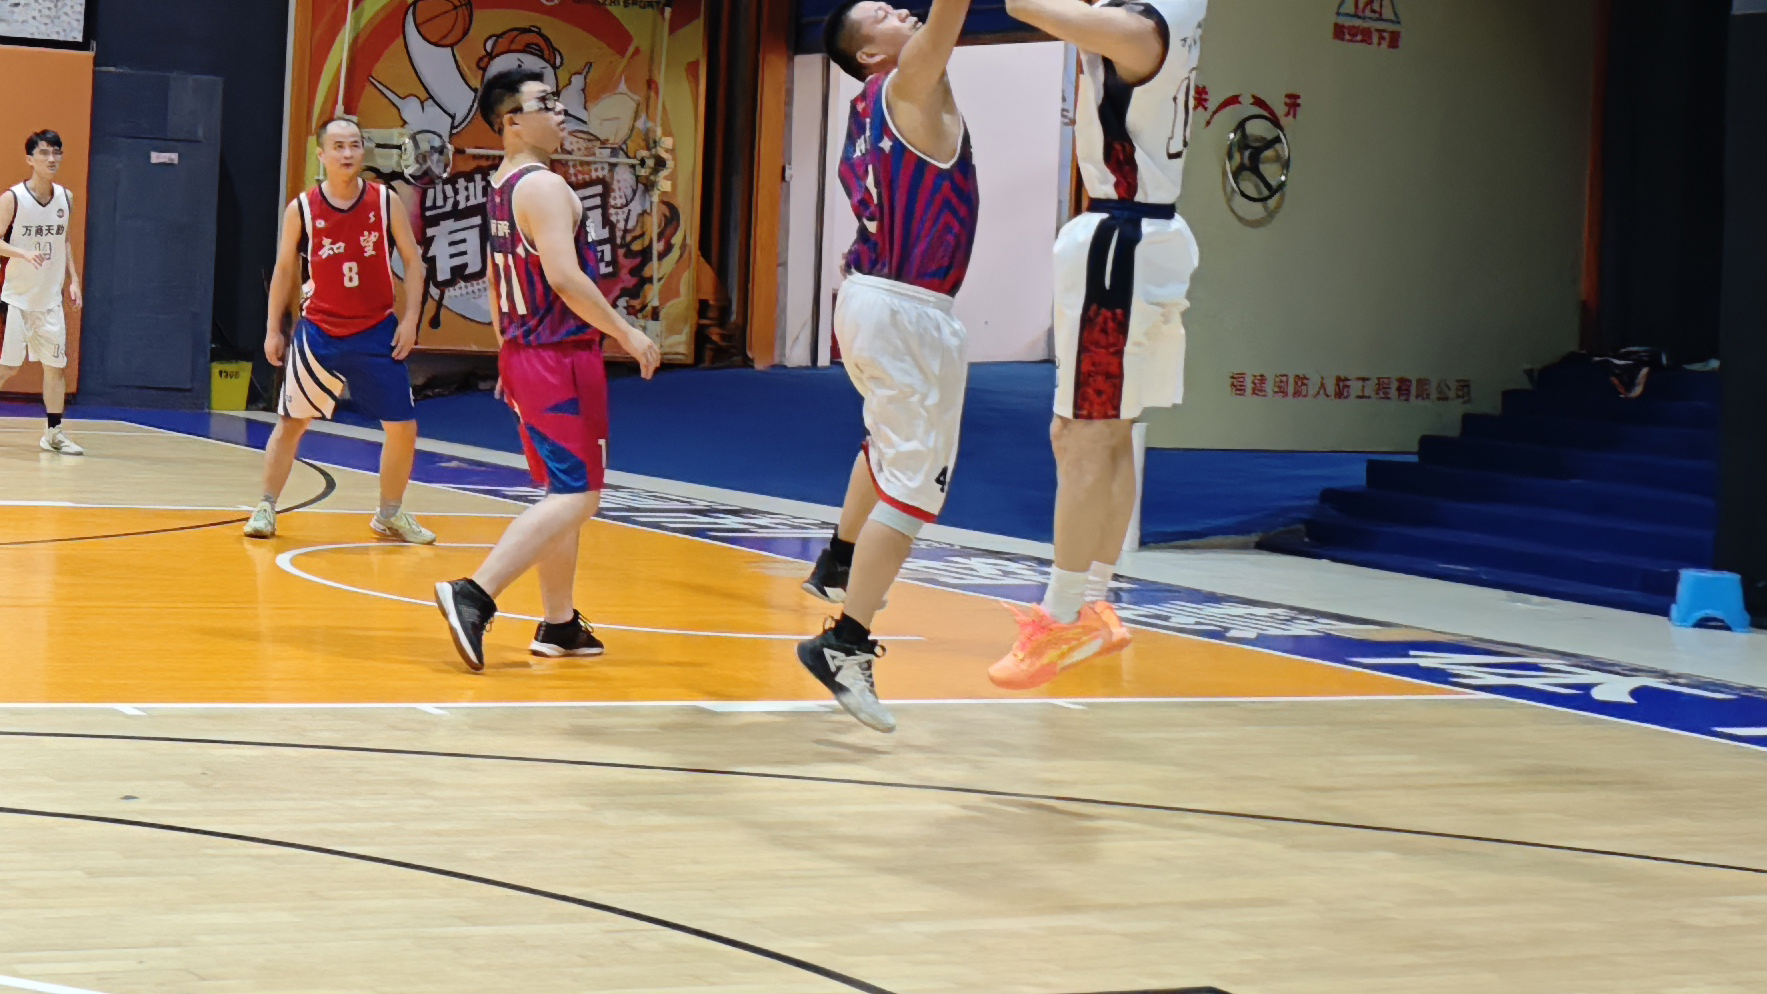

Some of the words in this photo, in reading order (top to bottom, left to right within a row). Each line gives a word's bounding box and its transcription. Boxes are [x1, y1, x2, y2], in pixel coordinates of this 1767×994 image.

[1283, 93, 1301, 119] 开
[425, 171, 495, 216] 少扯
[22, 224, 65, 237] 万商天勤
[342, 261, 359, 287] 8
[1229, 372, 1472, 403] 福建闽防人防工程有限公司
[935, 466, 949, 493] 4
